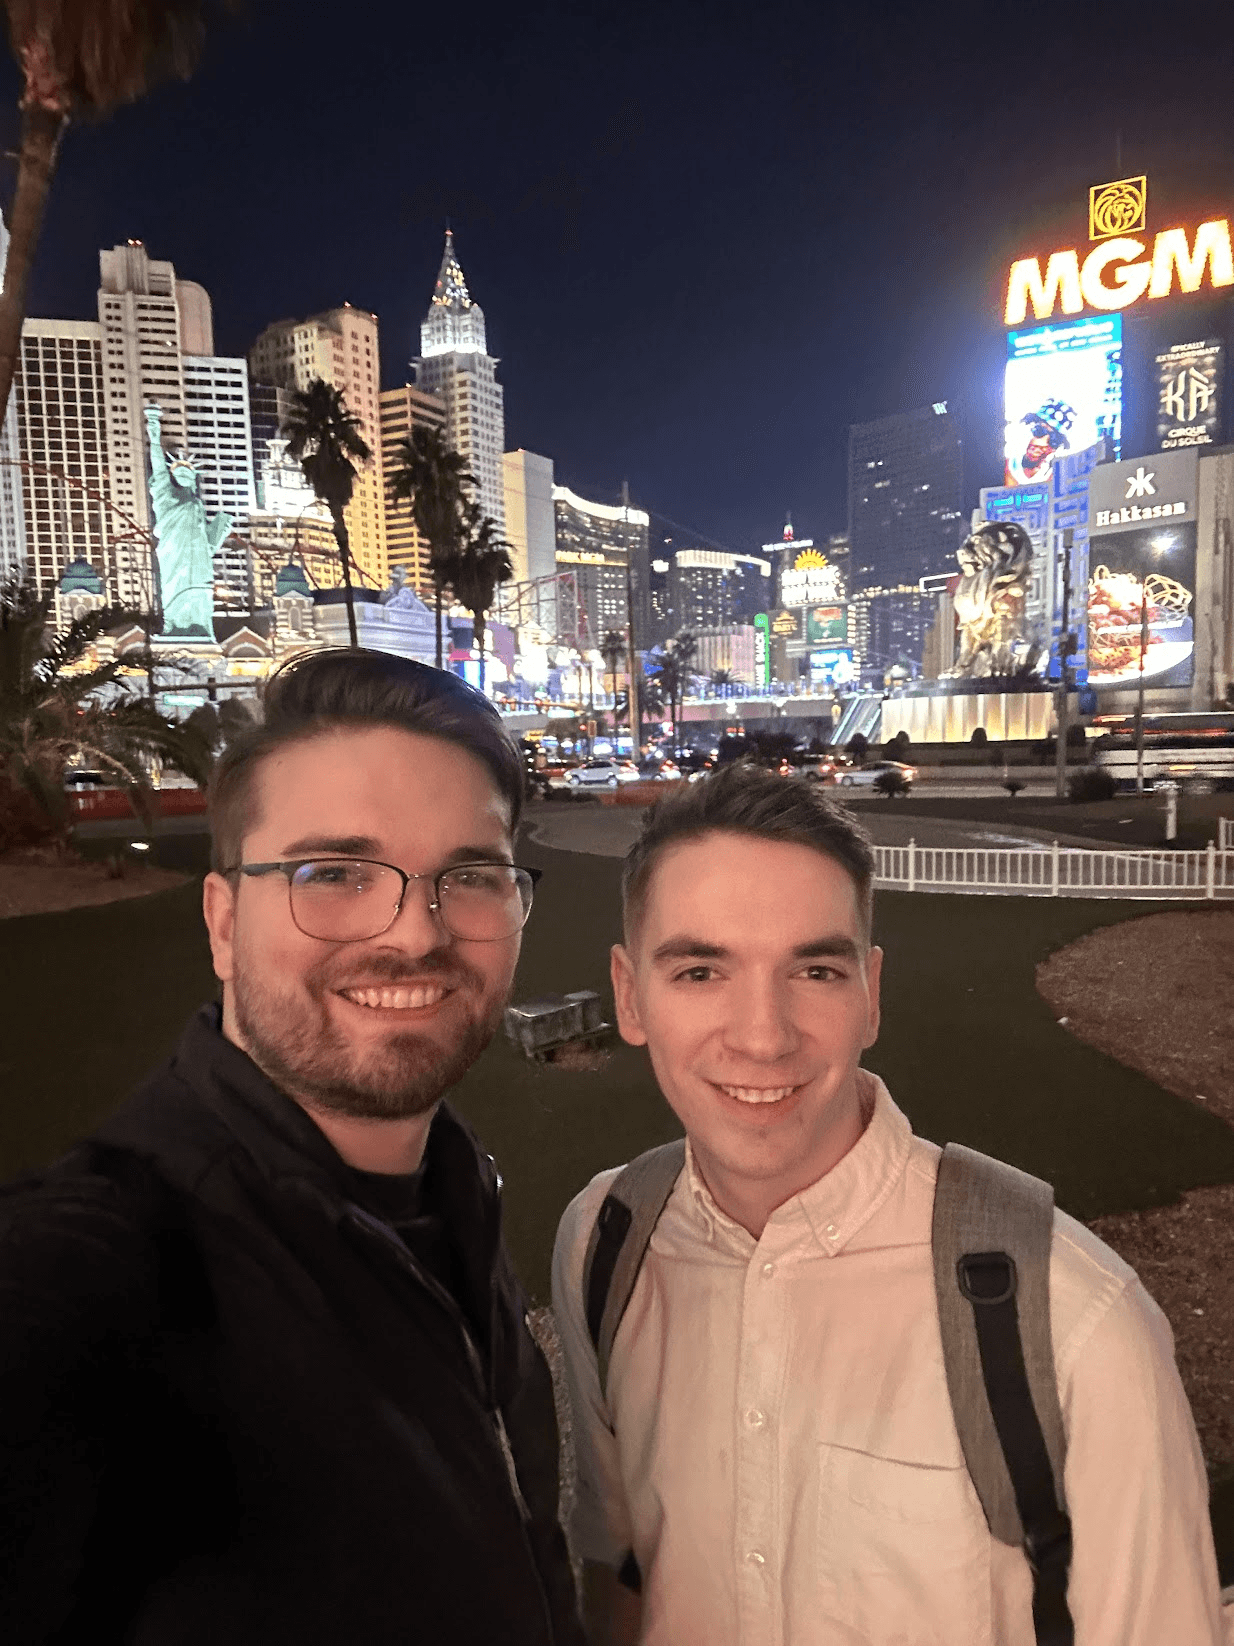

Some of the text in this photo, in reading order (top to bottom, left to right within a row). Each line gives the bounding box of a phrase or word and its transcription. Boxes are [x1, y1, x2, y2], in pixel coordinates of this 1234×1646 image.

[1004, 219, 1234, 325] MGM
[1168, 425, 1206, 438] CIRQUE
[1161, 435, 1213, 449] DU SOLEIL
[1096, 502, 1186, 527] Hakkasan
